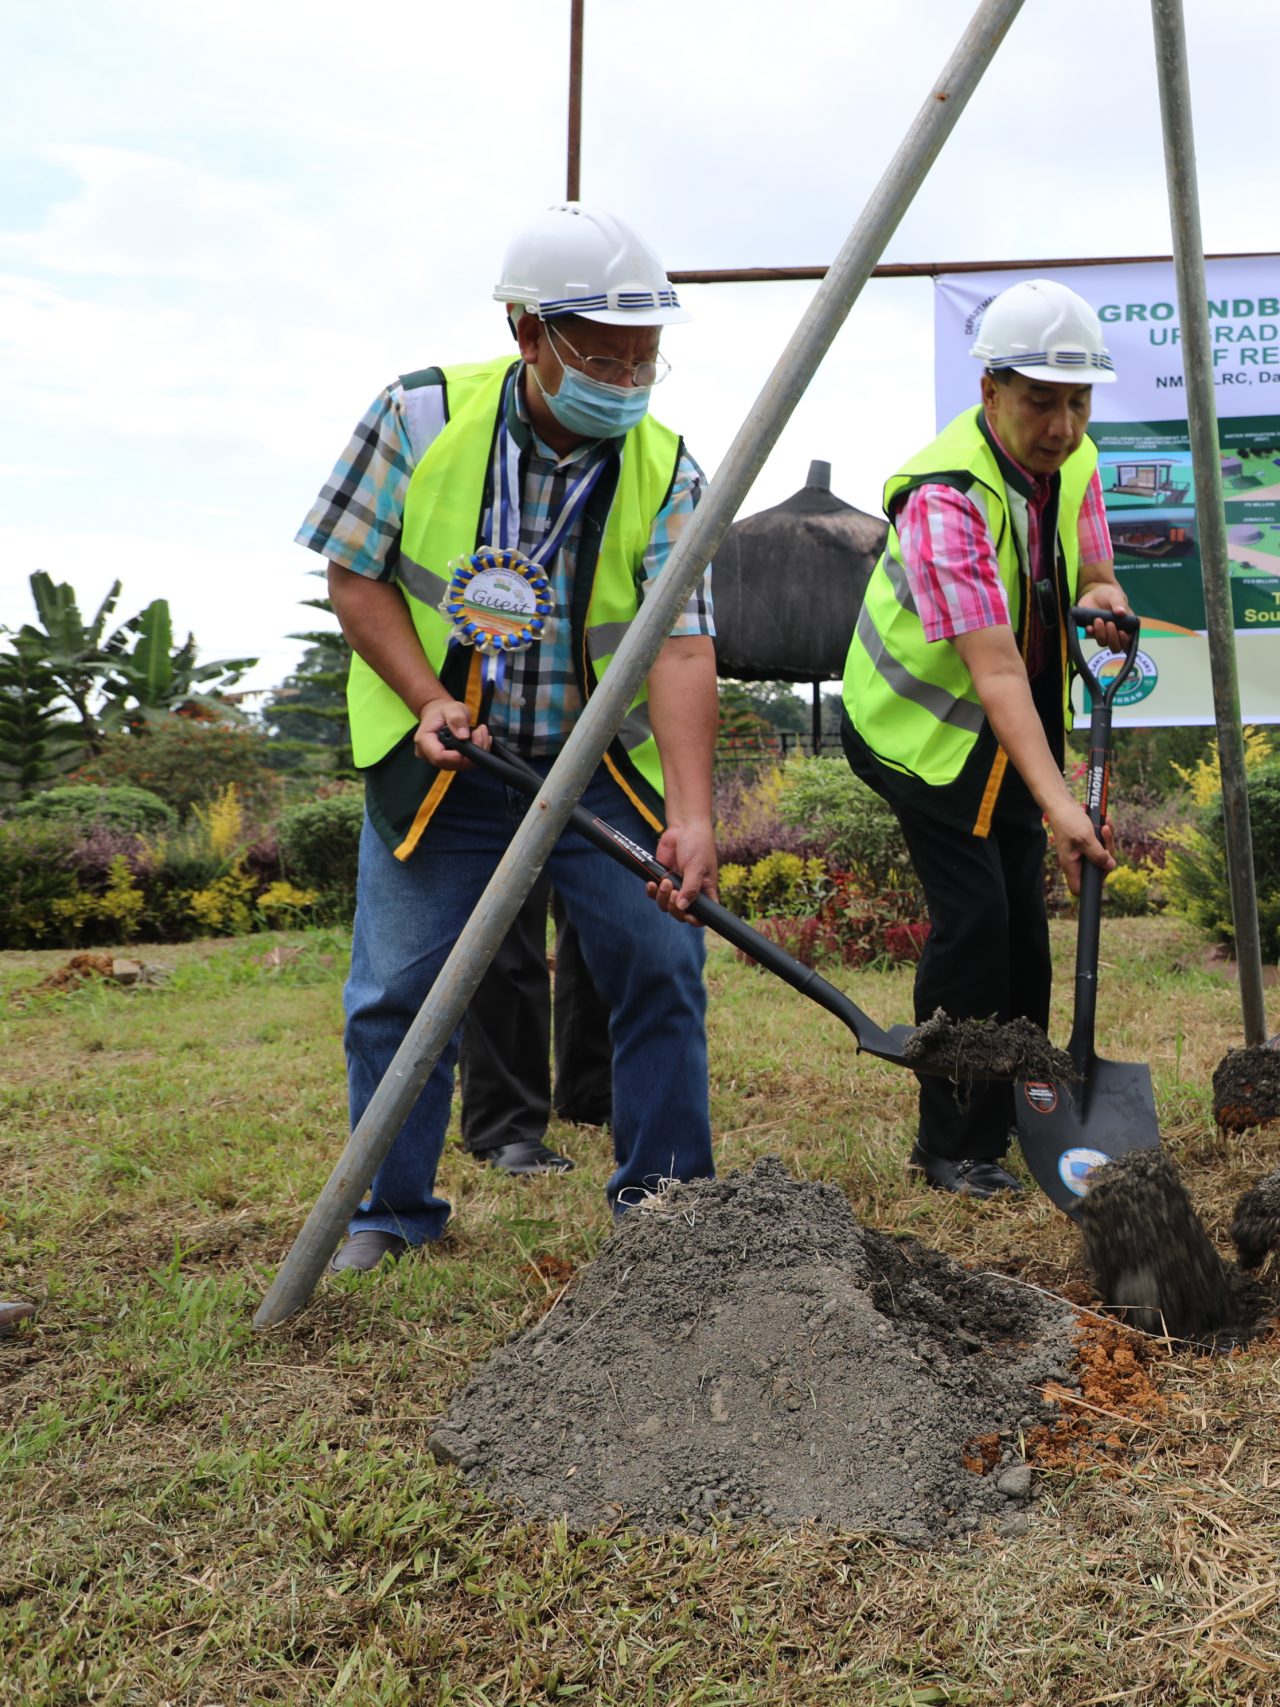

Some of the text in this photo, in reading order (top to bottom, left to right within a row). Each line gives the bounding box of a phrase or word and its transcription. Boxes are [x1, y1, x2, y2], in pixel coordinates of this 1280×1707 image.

[1213, 348, 1230, 366] F
[472, 590, 530, 613] Guest
[1090, 765, 1103, 810] SHOVEL
